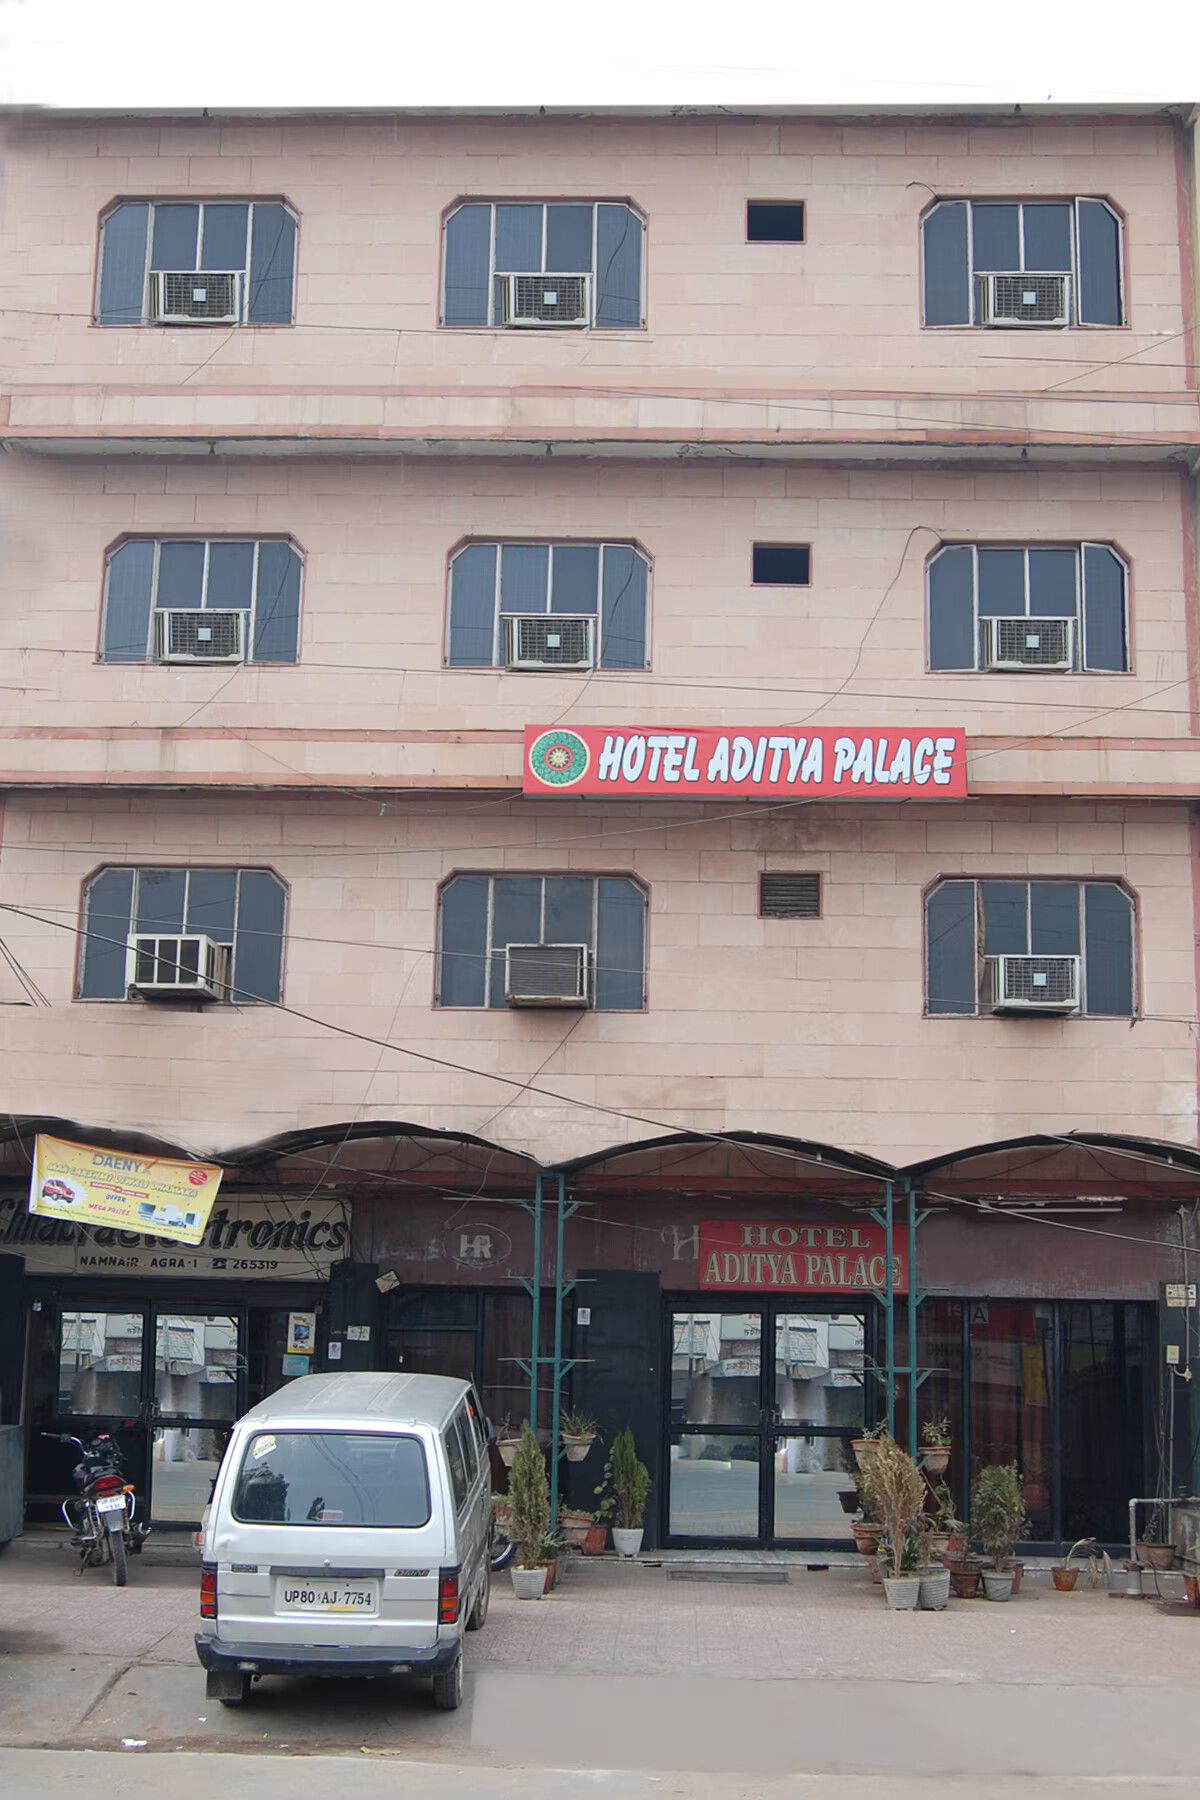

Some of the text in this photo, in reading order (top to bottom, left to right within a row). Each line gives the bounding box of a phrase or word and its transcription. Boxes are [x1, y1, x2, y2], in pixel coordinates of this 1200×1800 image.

[597, 735, 956, 785] HOTEL ADITYA PALACE
[740, 1225, 871, 1248] HOTEL
[232, 1258, 278, 1269] 265319
[704, 1251, 902, 1287] ADITYA PALACE
[284, 1590, 315, 1603] UP80
[344, 1591, 372, 1605] 7754
